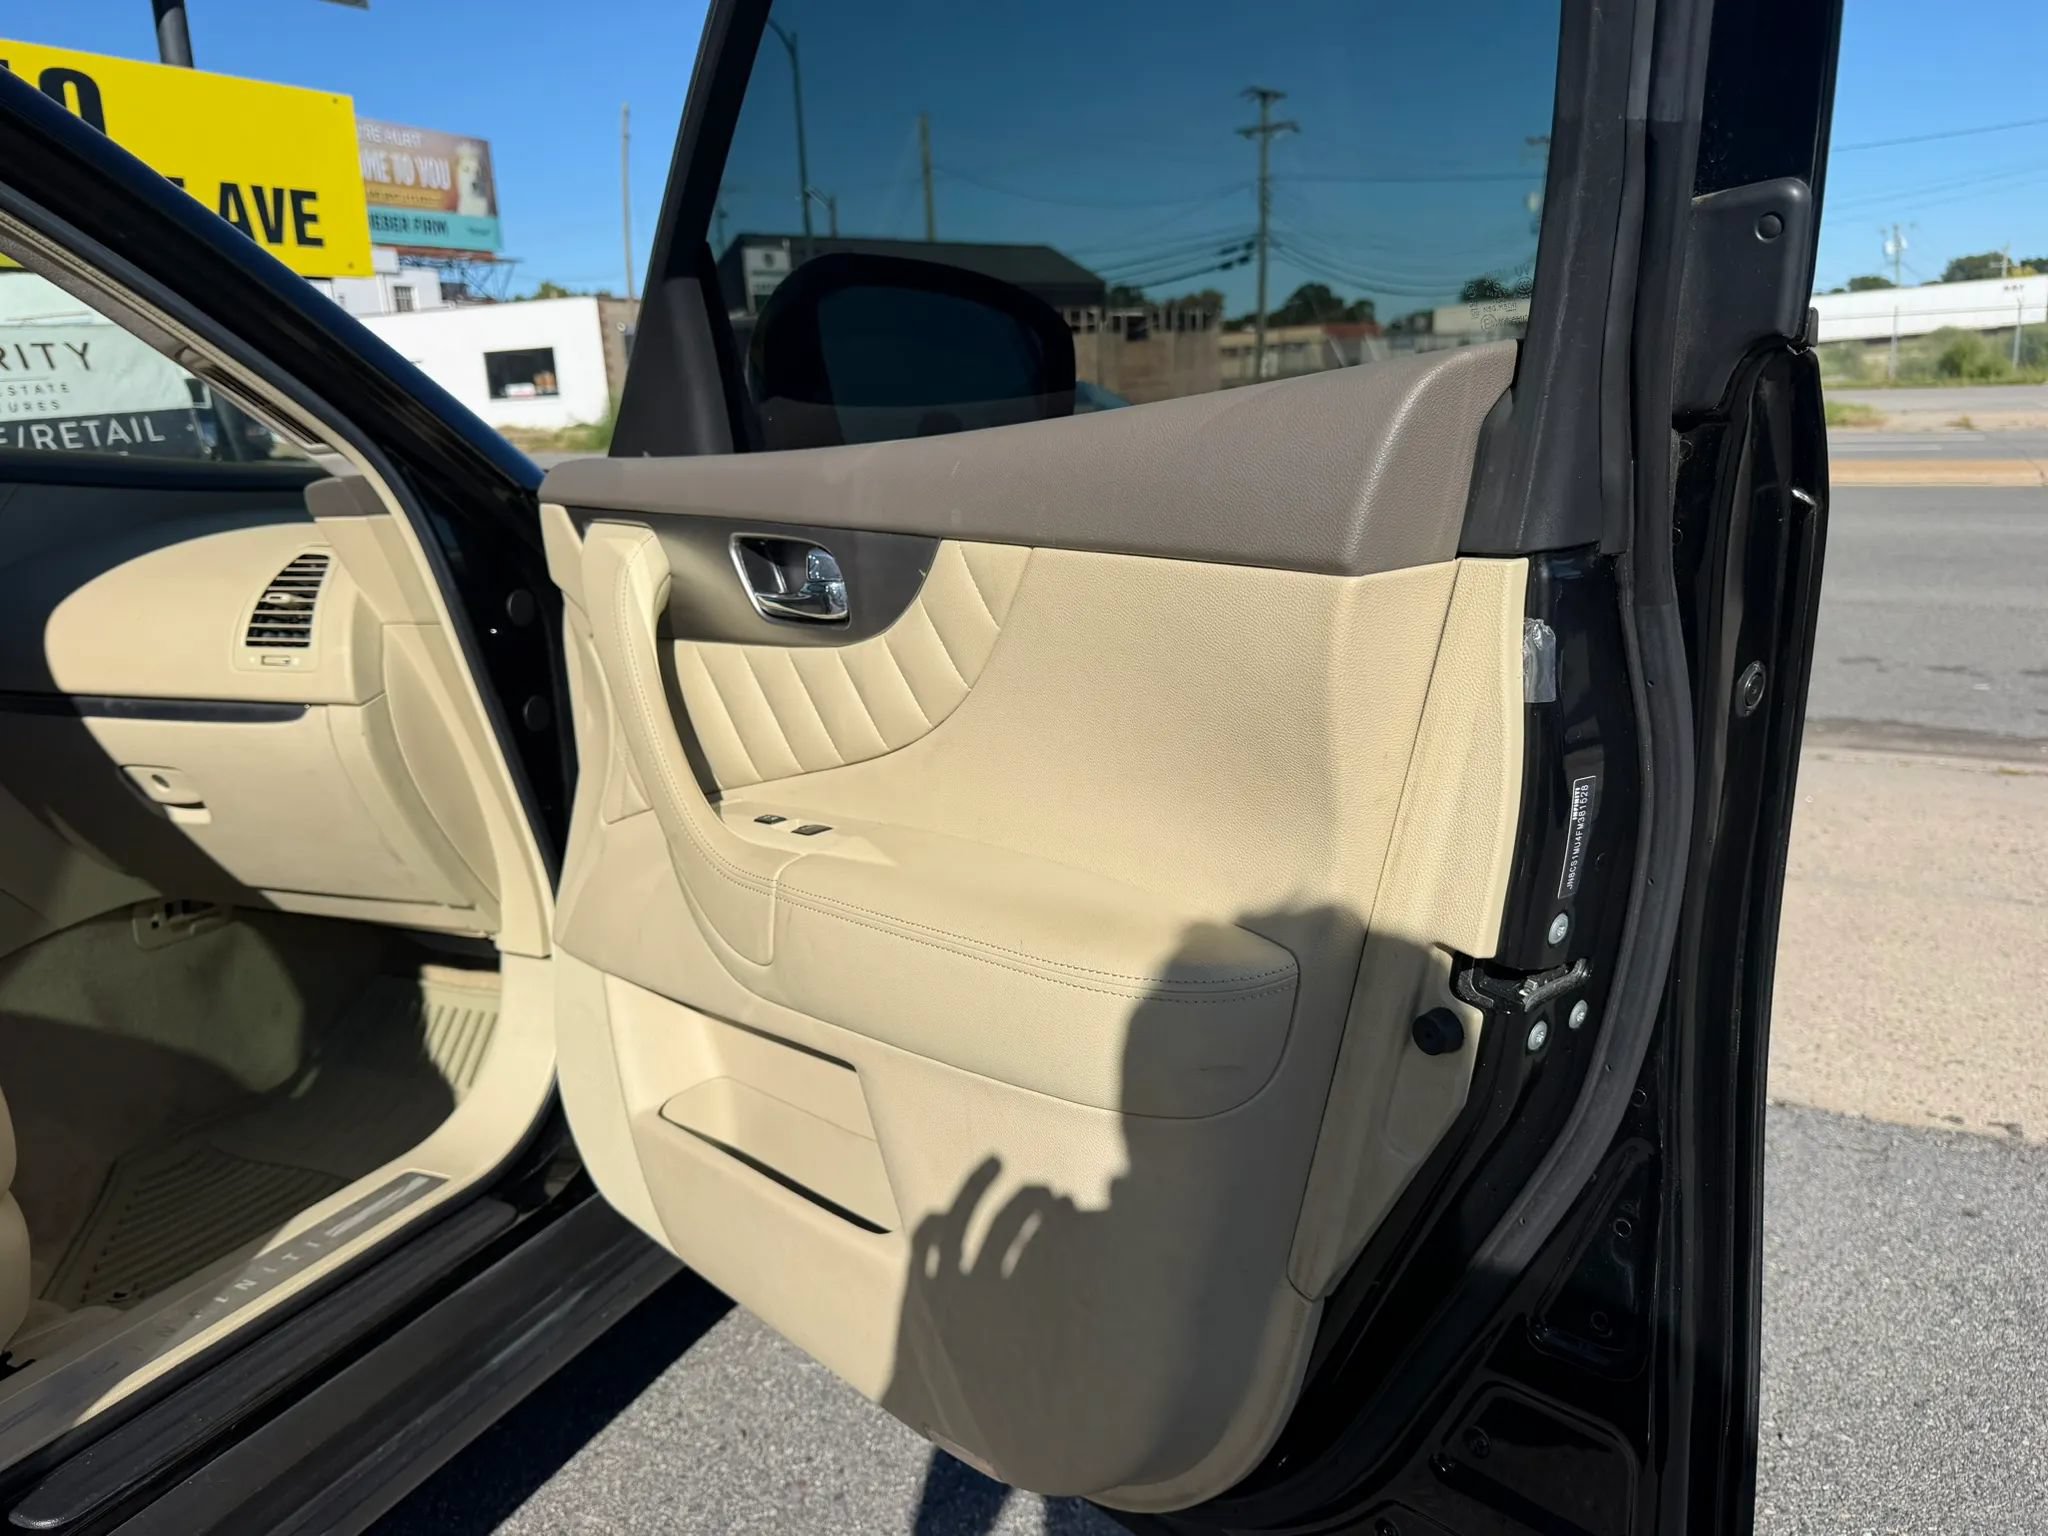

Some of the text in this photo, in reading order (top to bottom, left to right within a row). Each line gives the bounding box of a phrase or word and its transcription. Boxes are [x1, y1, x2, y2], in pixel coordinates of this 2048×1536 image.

[389, 152, 416, 187] TO
[414, 155, 452, 191] YOU
[218, 182, 325, 248] AVE
[0, 382, 70, 398] STATE
[0, 400, 61, 413] URES
